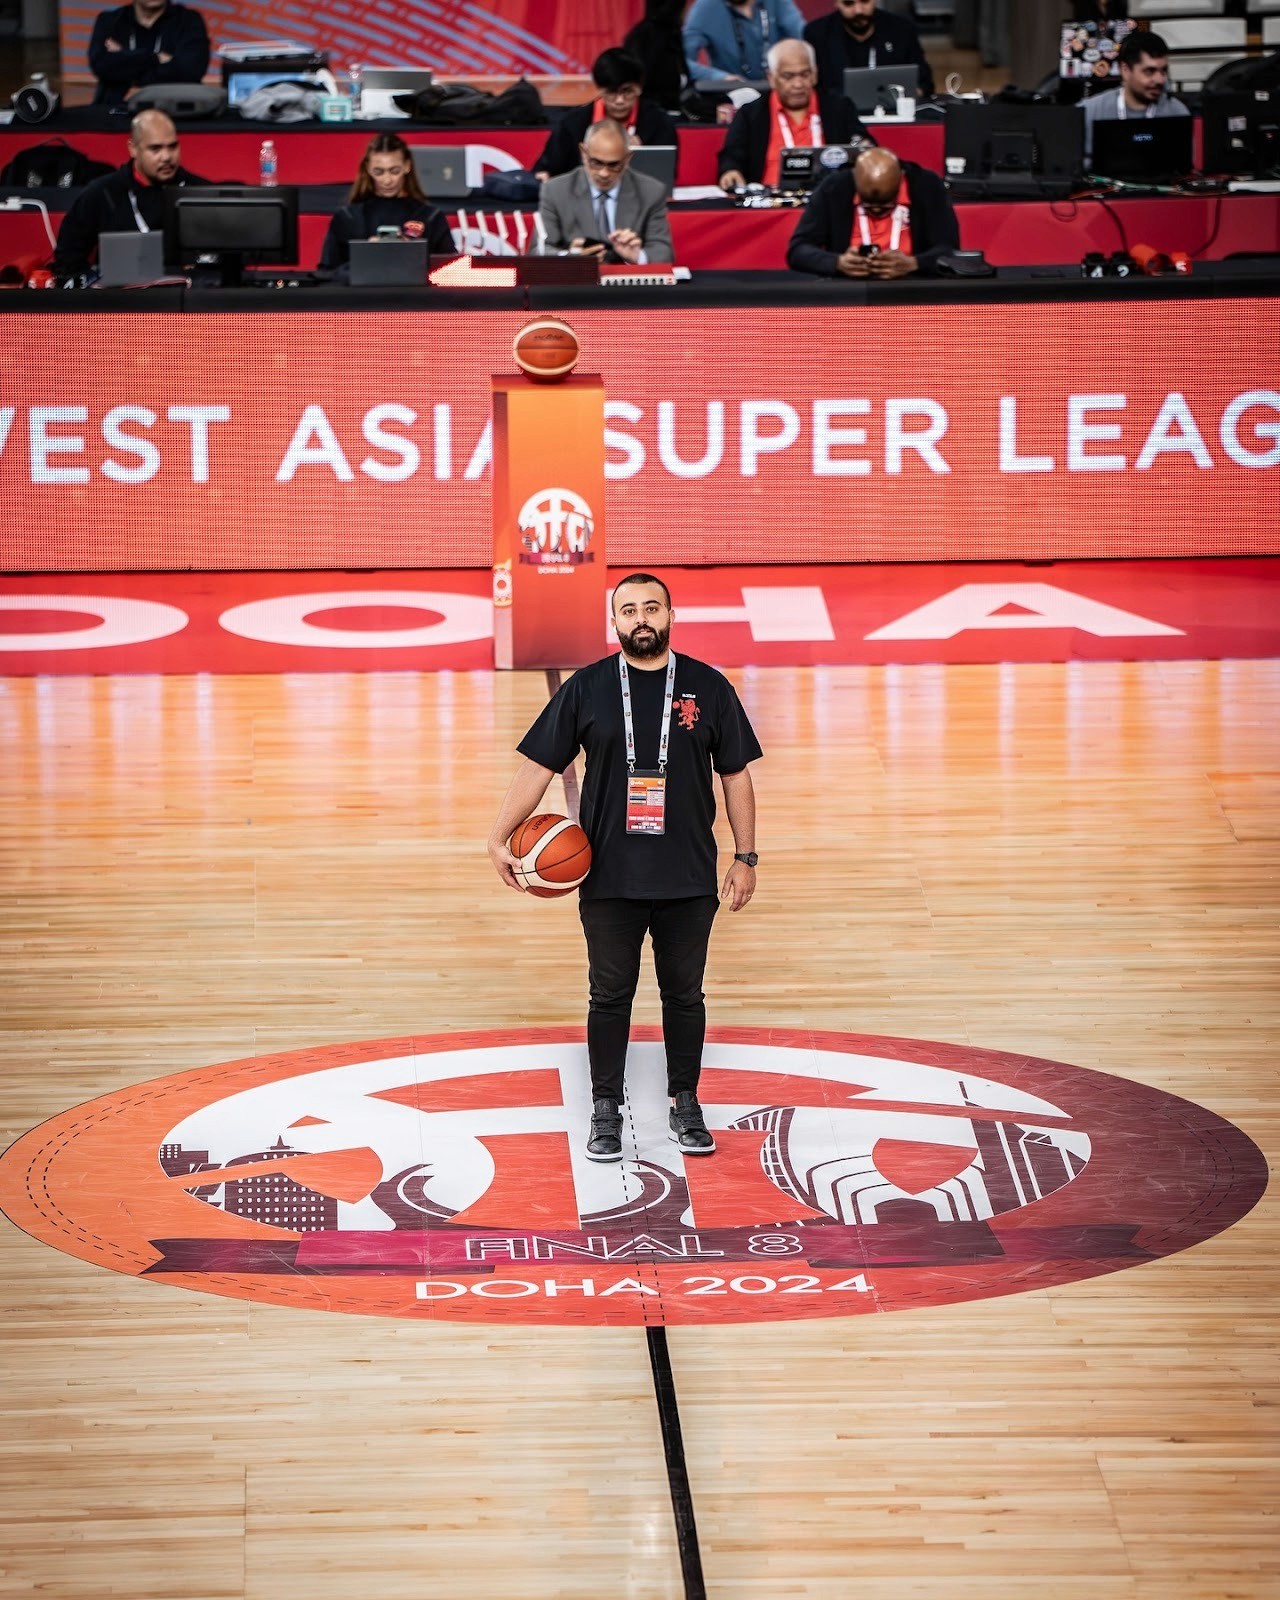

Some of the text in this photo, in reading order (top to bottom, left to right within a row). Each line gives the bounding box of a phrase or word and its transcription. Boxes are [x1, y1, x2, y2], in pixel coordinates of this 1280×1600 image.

[0, 405, 231, 484] EST
[465, 1233, 804, 1261] FINAL 8
[415, 1273, 875, 1300] DOHA 2024
